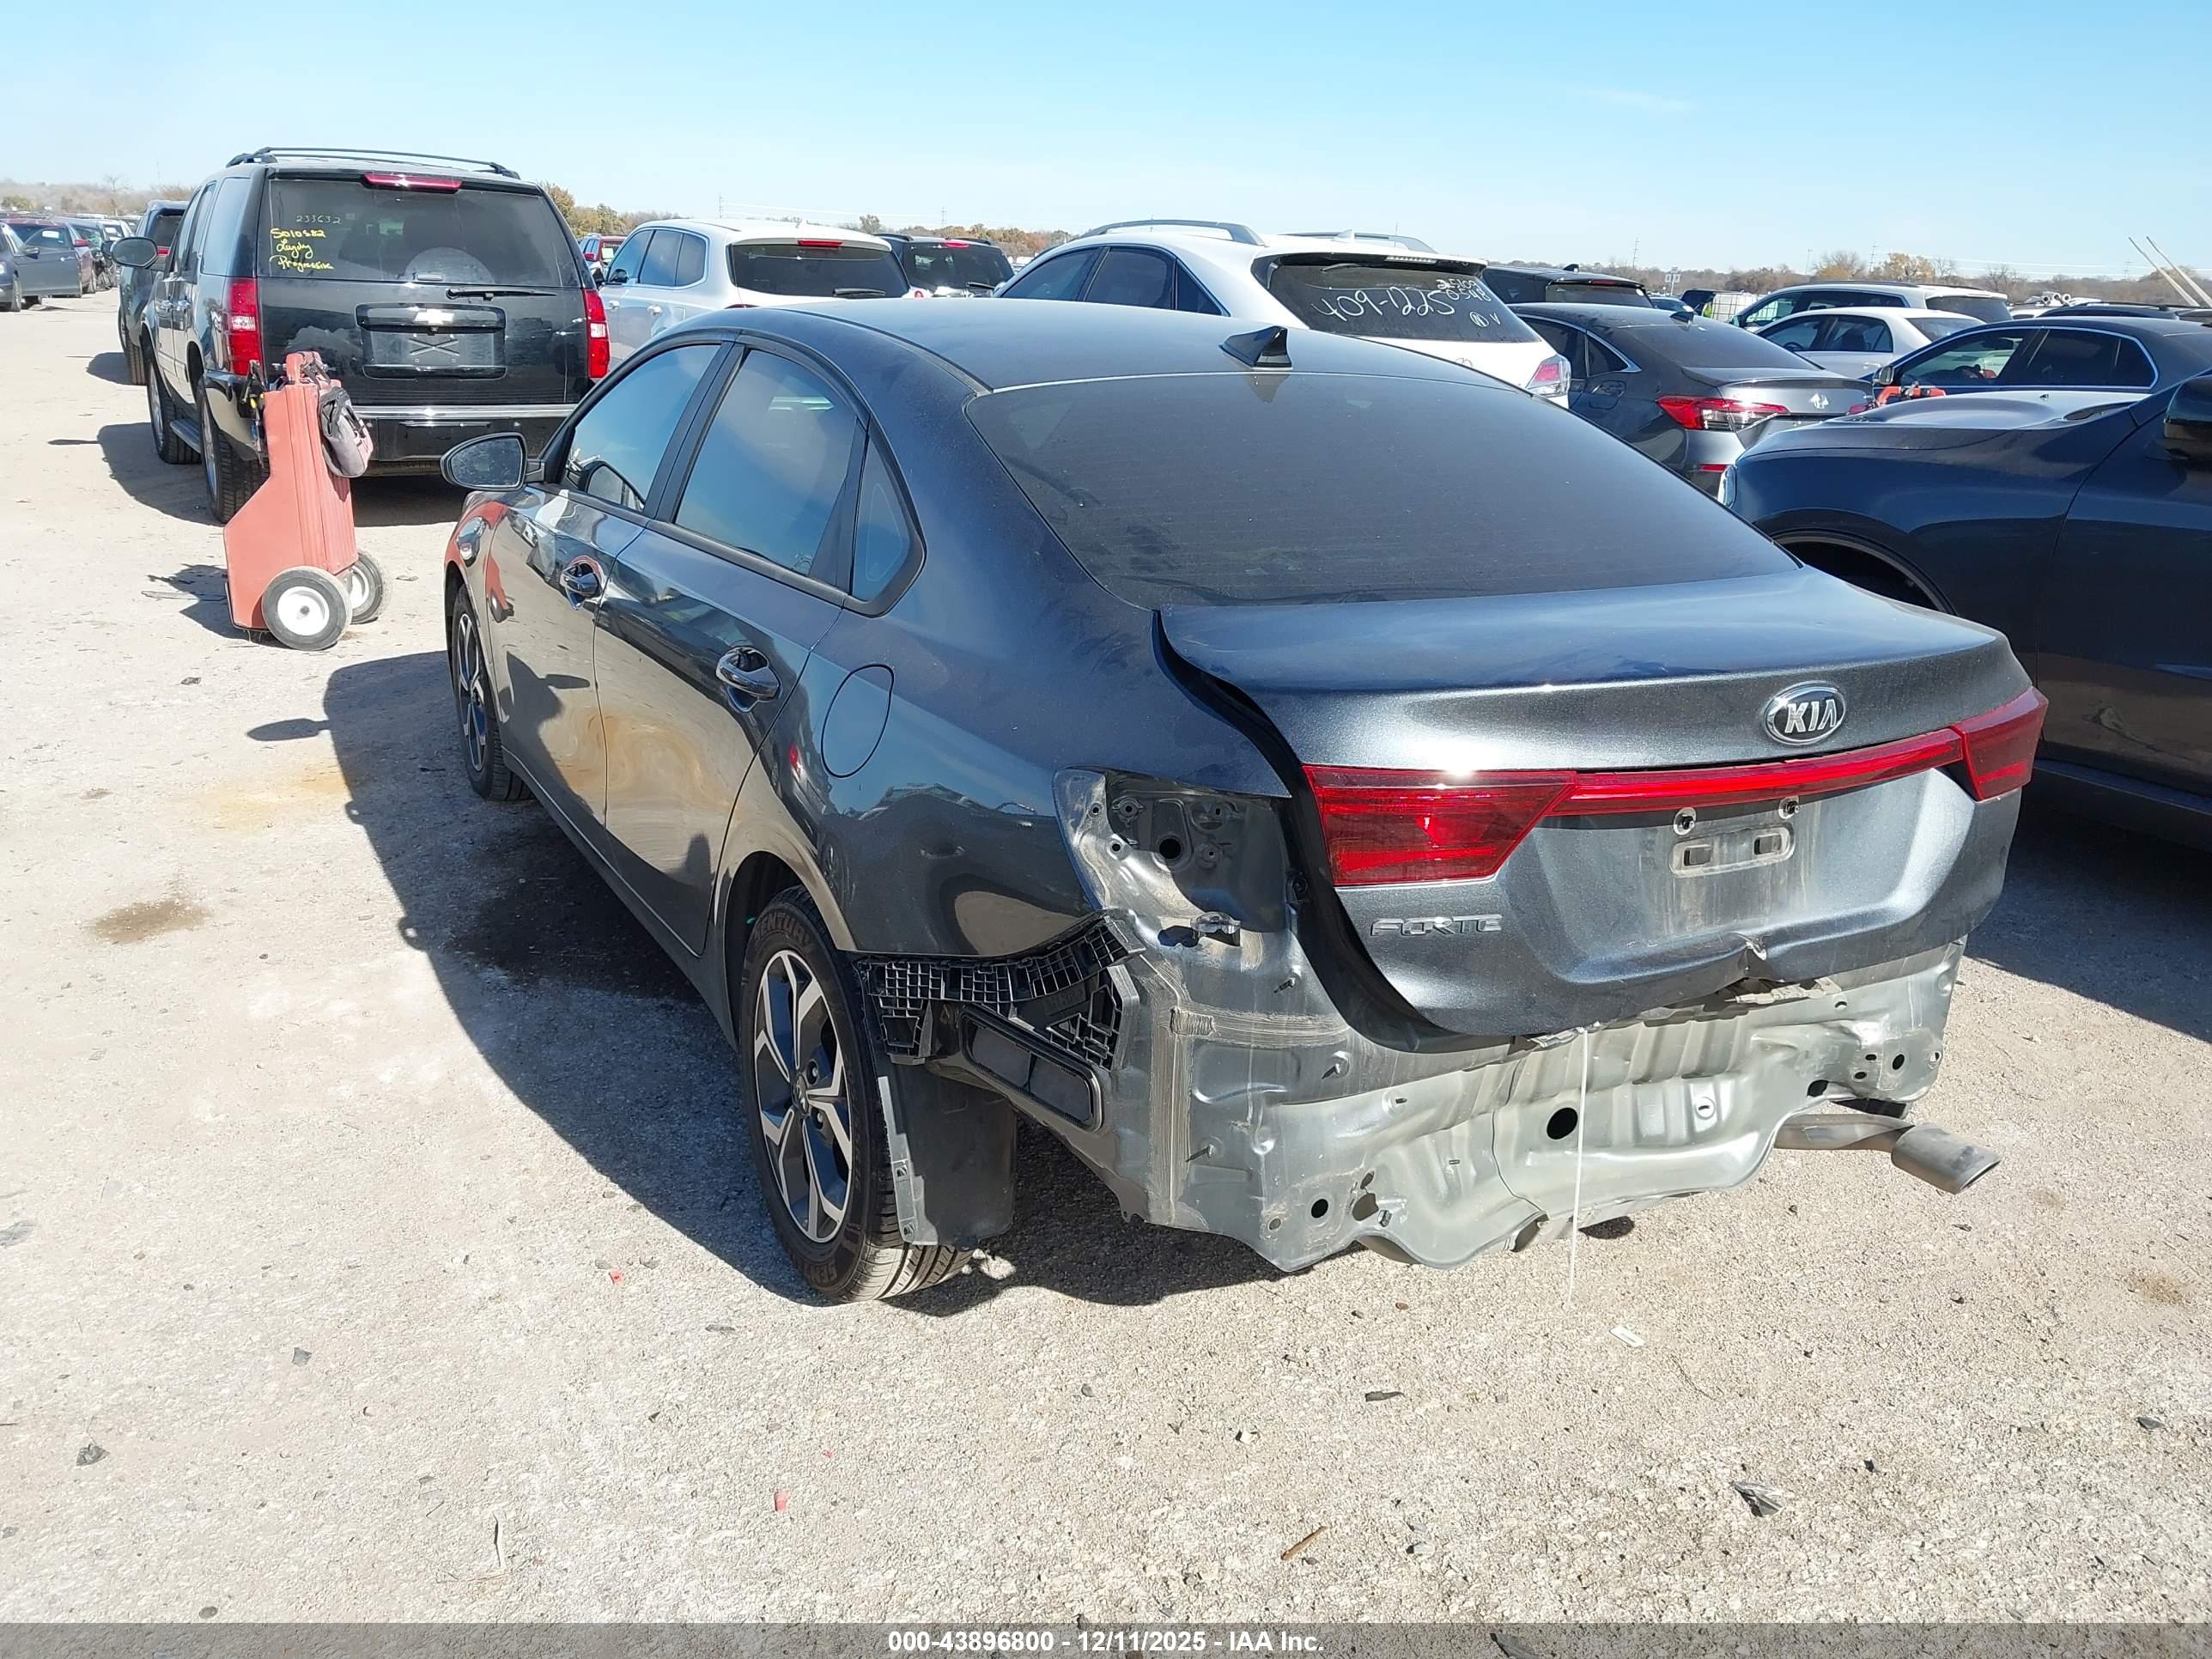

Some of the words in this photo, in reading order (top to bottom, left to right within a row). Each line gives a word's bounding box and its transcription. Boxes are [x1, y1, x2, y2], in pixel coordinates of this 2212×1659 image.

[269, 254, 335, 273] Progressive
[1784, 698, 1838, 733] KIA
[1370, 914, 1503, 937] FORTE
